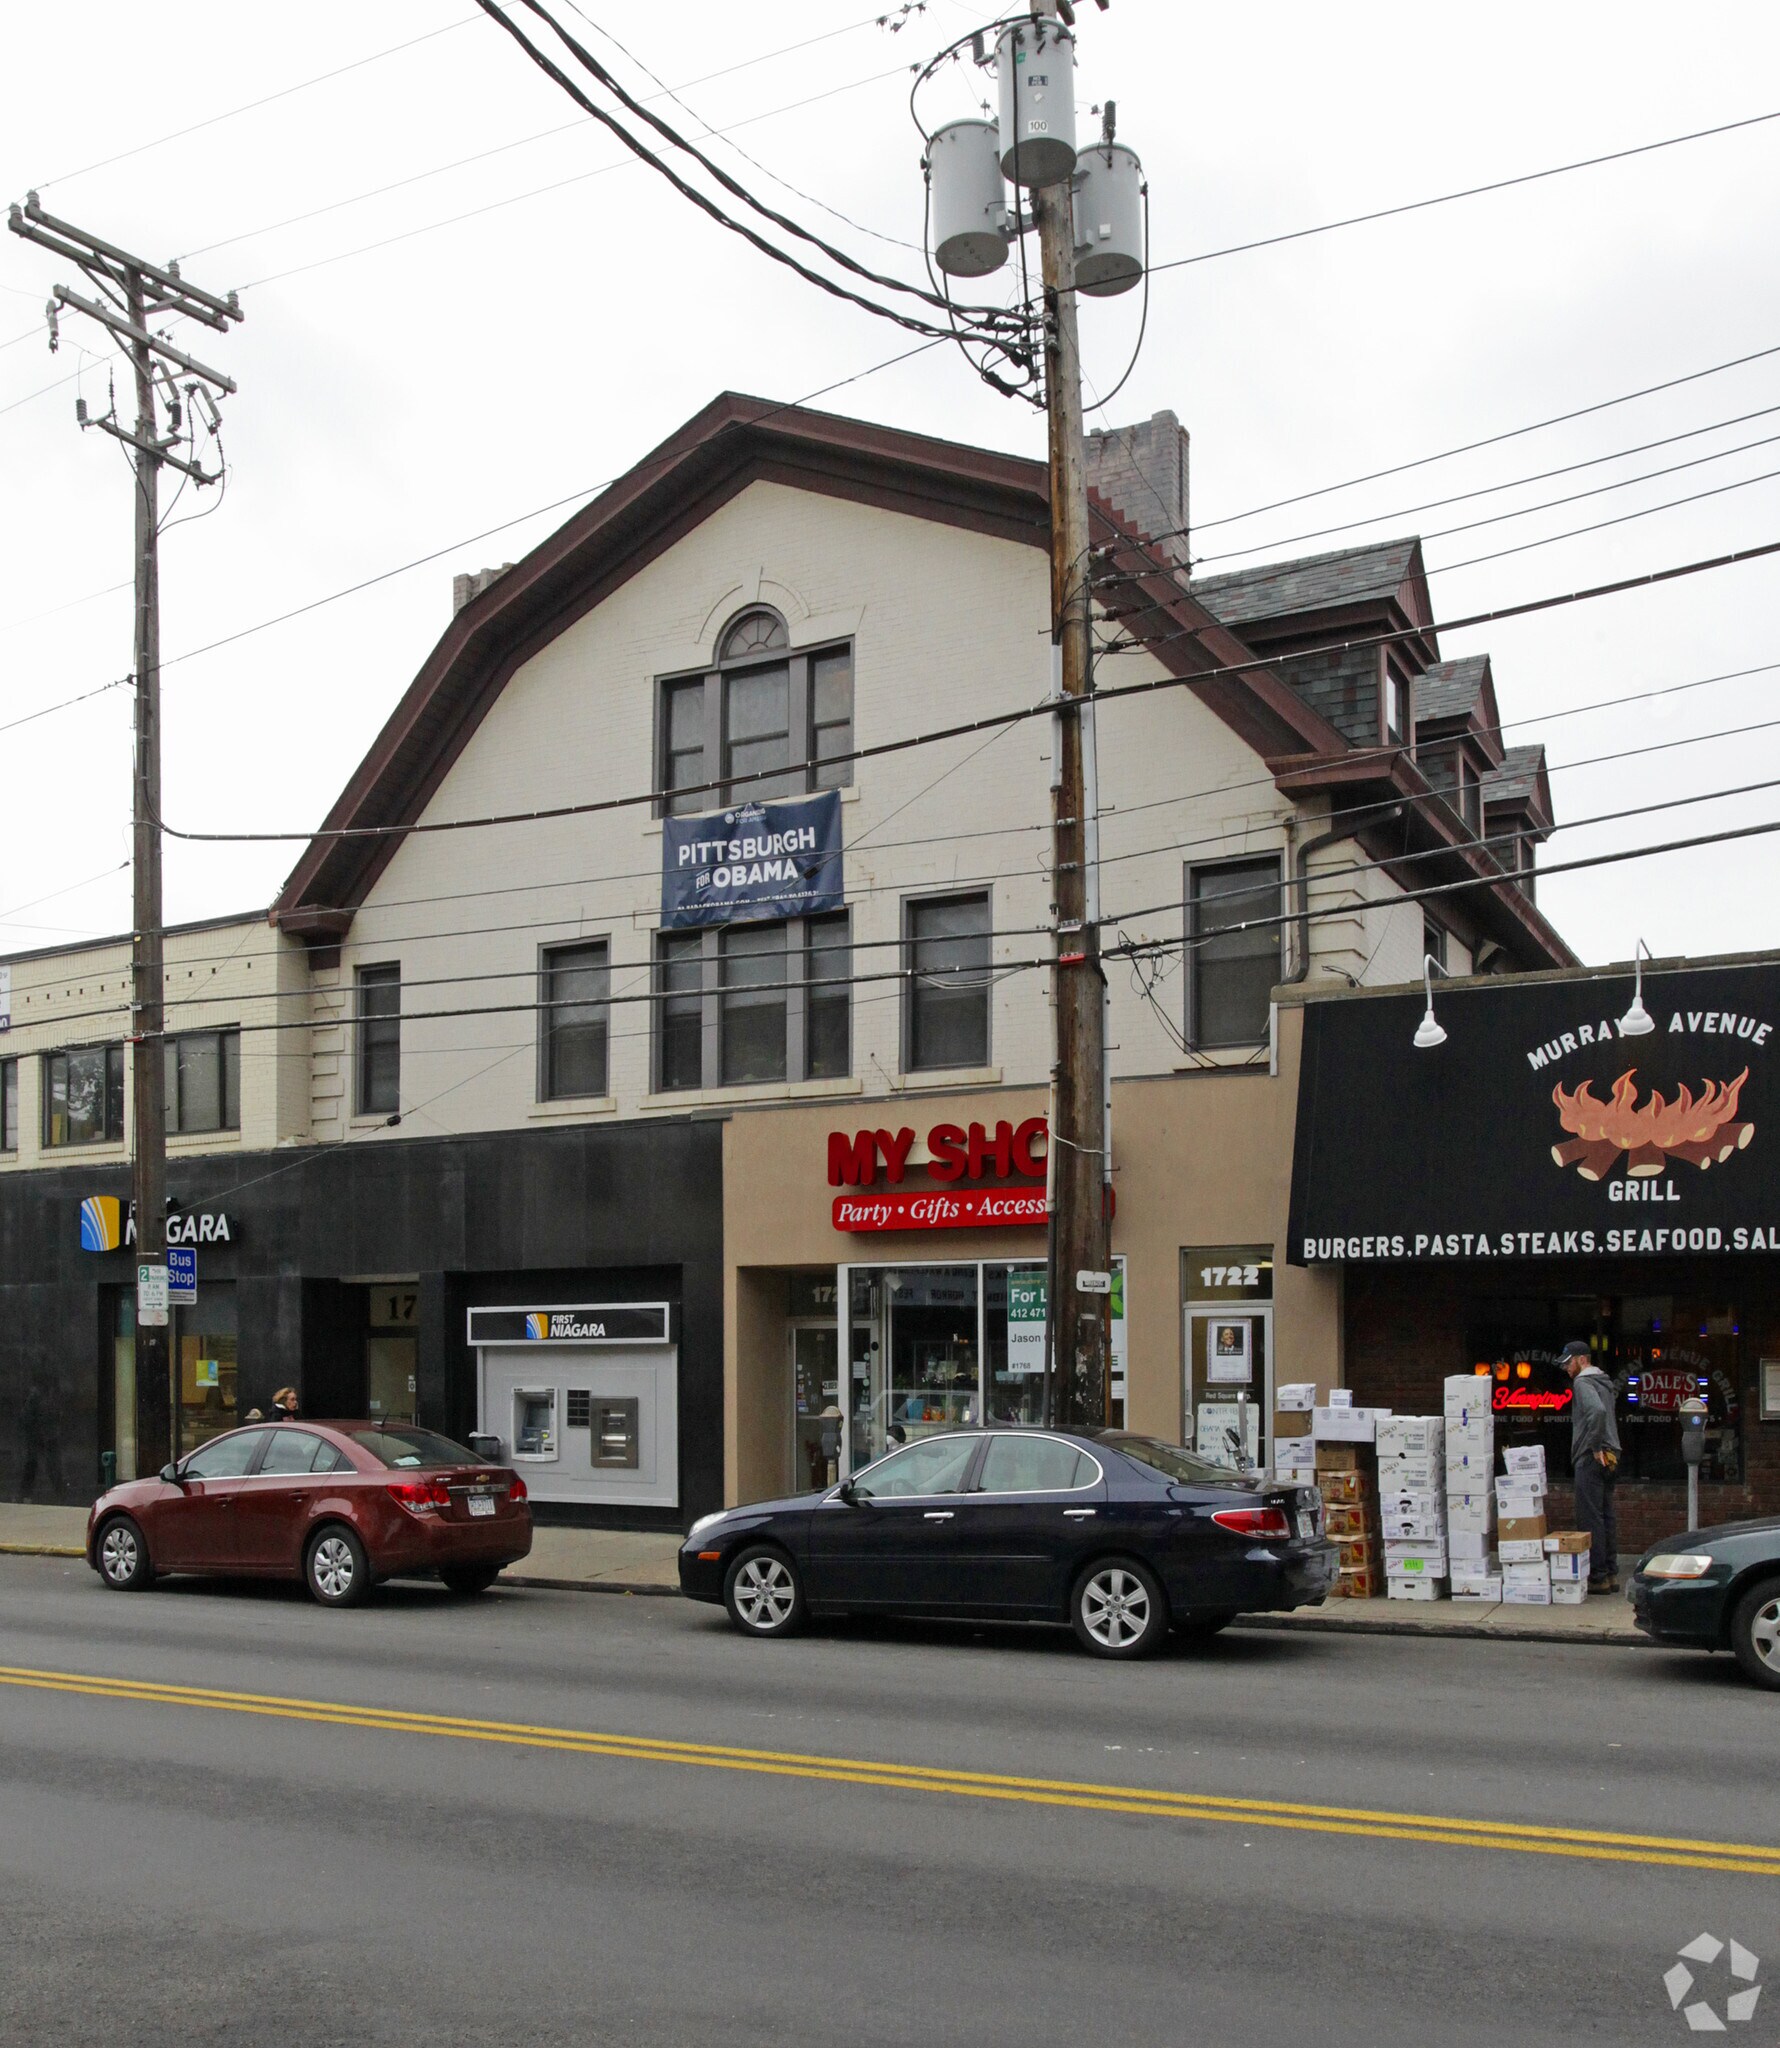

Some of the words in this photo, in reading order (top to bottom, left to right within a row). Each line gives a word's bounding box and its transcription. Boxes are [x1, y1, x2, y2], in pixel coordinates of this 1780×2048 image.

[1030, 121, 1047, 131] 100
[679, 826, 816, 867] PITTSBURGH
[696, 871, 711, 889] FOR
[712, 858, 799, 889] OBAMA
[1668, 1011, 1773, 1046] AVENUE
[828, 1127, 916, 1187] MY
[1608, 1180, 1681, 1201] GRILL
[838, 1203, 892, 1226] Party
[910, 1197, 960, 1225] Gifts
[125, 1213, 230, 1245] NGARA
[169, 1252, 192, 1267] Bus
[140, 1268, 148, 1281] 2
[168, 1269, 194, 1286] Stop
[1200, 1266, 1259, 1287] 1722
[1010, 1288, 1037, 1303] For
[389, 1295, 417, 1320] 17
[1011, 1309, 1028, 1318] 412
[1030, 1308, 1046, 1318] 471
[551, 1315, 575, 1324] FIRST
[550, 1323, 606, 1337] NIAGARA
[1011, 1333, 1041, 1343] Jason
[1640, 1371, 1697, 1392] DALE'S
[1640, 1393, 1669, 1408] PALE
[1511, 1415, 1534, 1423] FOOD
